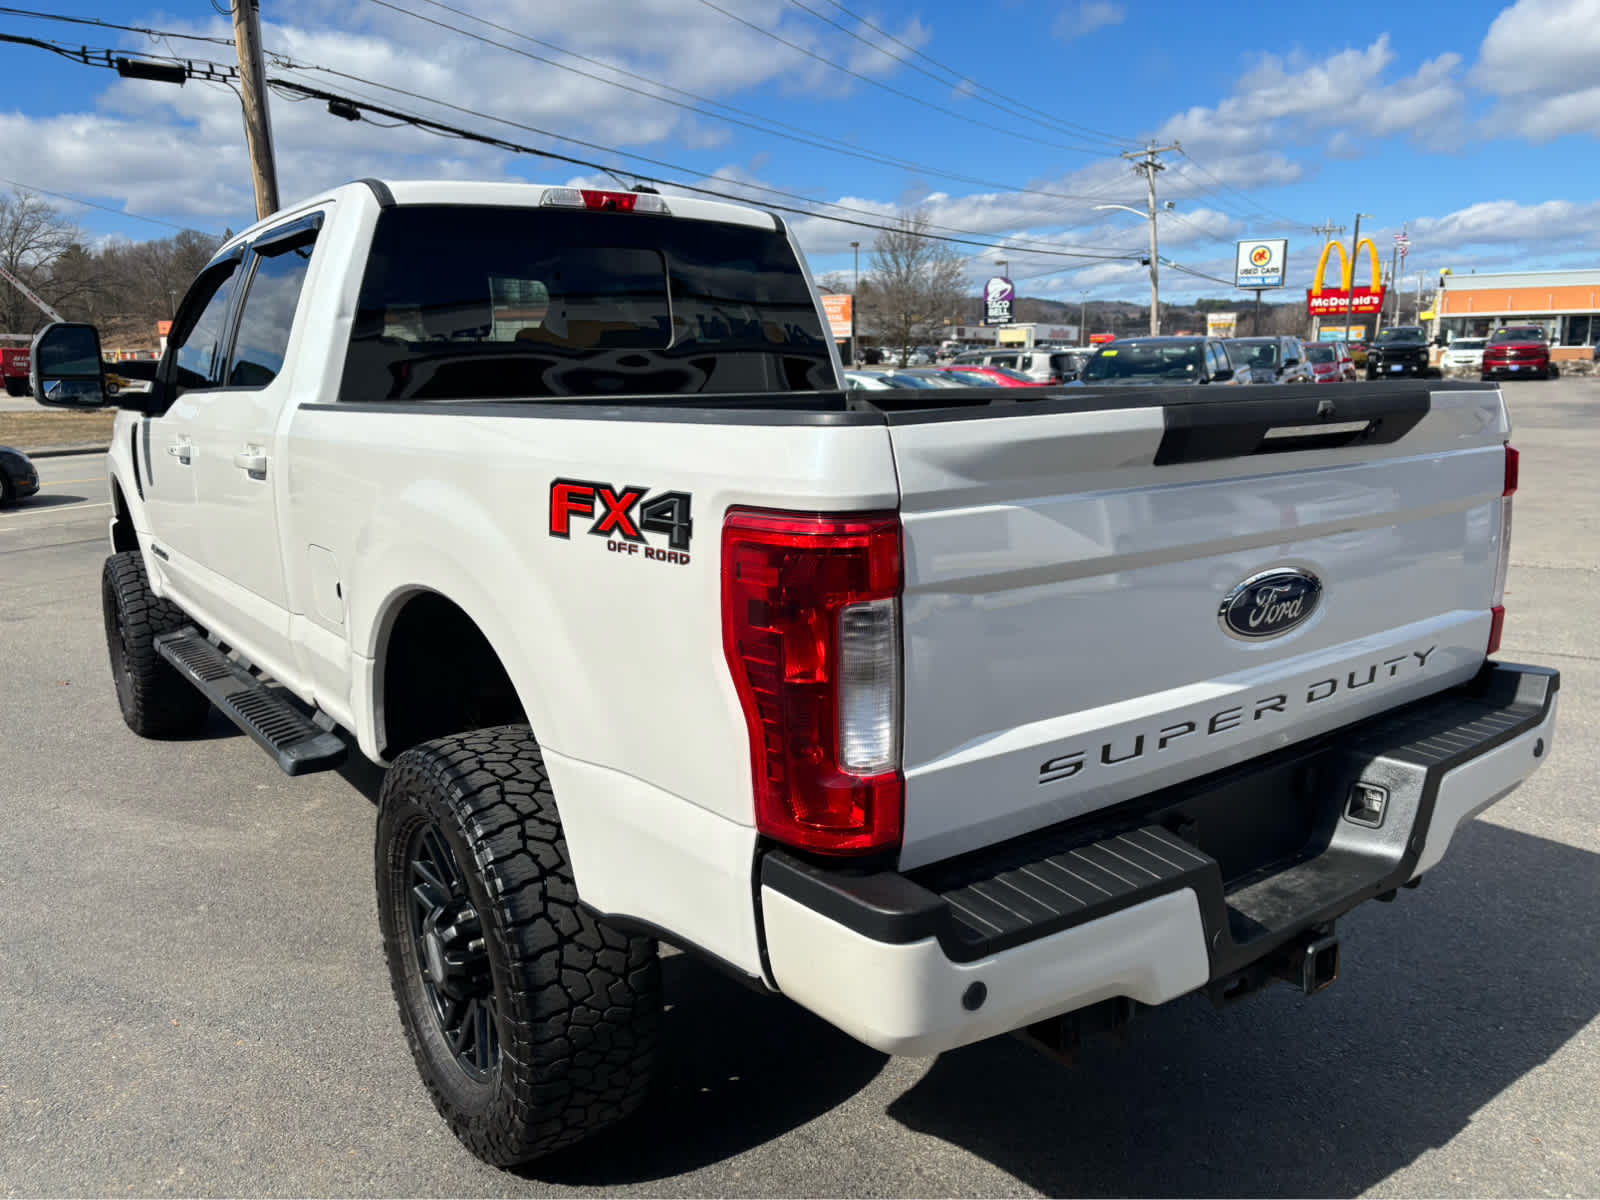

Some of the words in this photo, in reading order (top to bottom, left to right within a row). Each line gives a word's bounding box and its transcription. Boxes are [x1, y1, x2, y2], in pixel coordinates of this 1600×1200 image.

[1240, 267, 1258, 275] USED
[987, 300, 1010, 309] TACO
[988, 308, 1010, 317] BELL
[549, 477, 693, 553] FX4
[606, 540, 639, 555] OFF
[644, 546, 691, 566] ROAD
[1248, 583, 1305, 628] Ford
[1038, 694, 1288, 785] SUPER
[1306, 645, 1437, 704] DUTY
